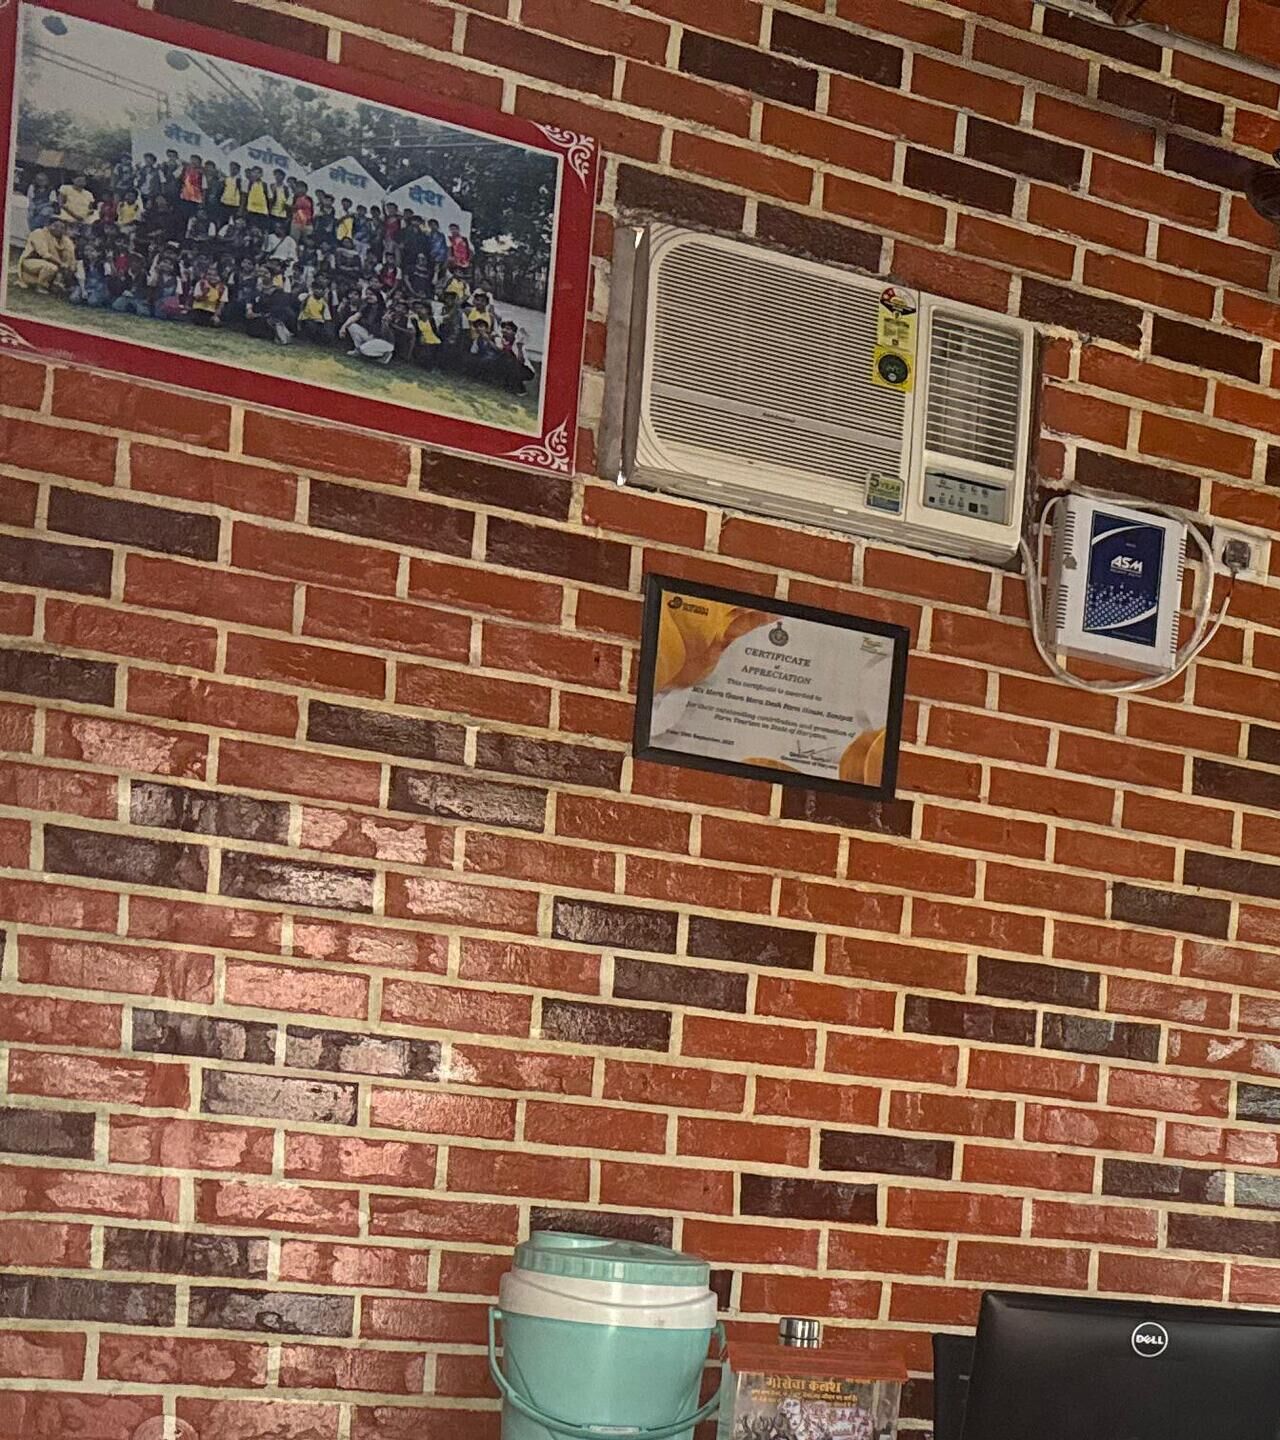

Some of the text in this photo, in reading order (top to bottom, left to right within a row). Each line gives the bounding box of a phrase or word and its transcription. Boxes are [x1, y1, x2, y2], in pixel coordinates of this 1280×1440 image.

[1111, 555, 1143, 574] ASM
[745, 647, 812, 668] CERTIFICATE
[741, 664, 812, 685] APPRECIATION
[1135, 1334, 1164, 1345] DELL
